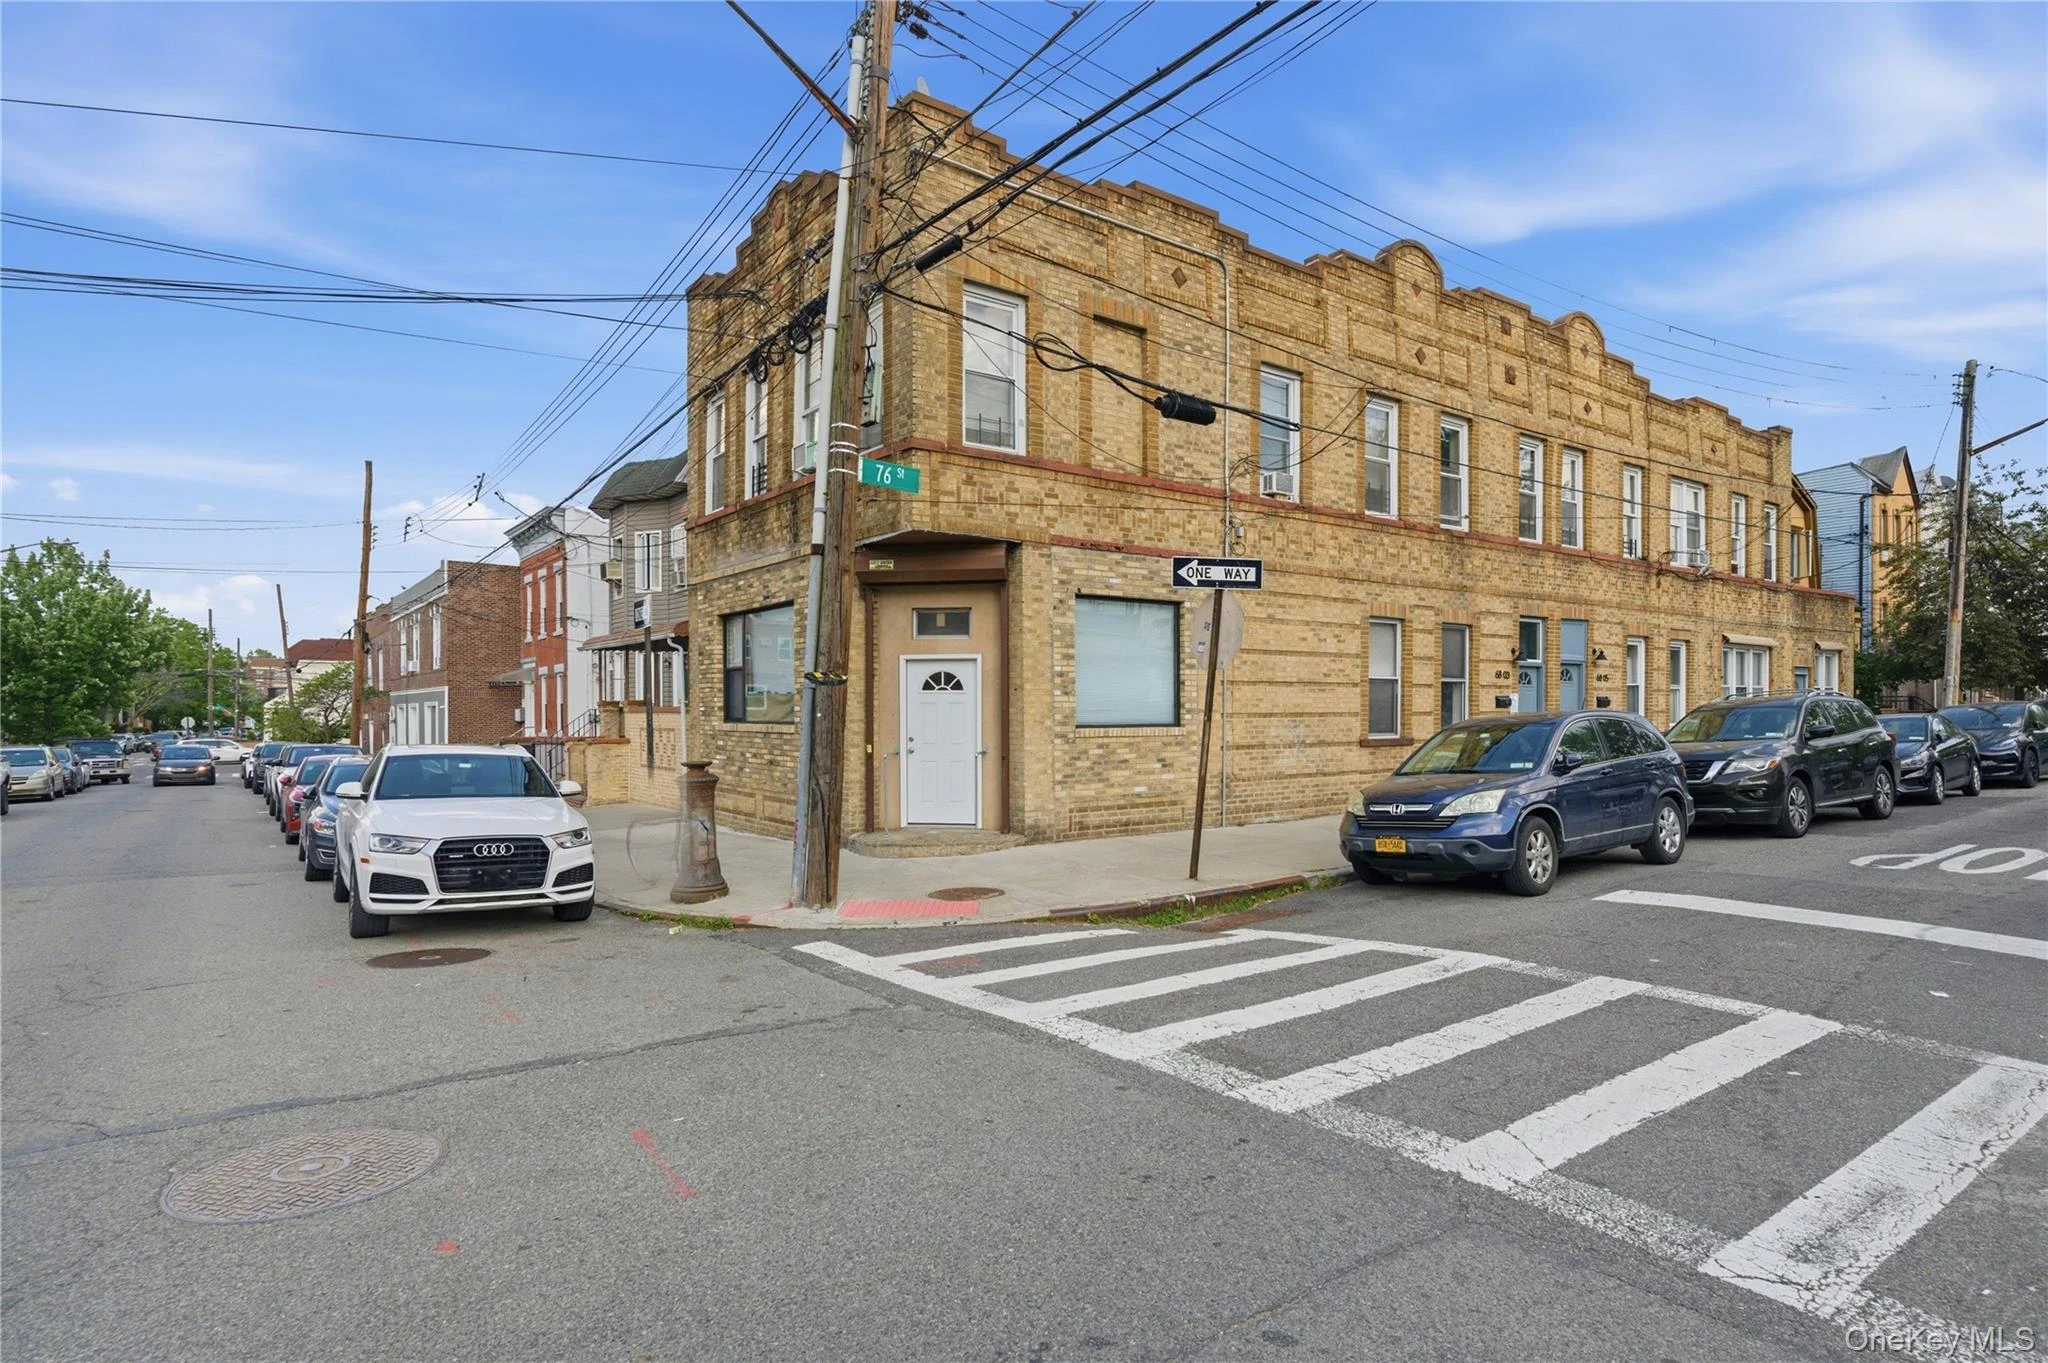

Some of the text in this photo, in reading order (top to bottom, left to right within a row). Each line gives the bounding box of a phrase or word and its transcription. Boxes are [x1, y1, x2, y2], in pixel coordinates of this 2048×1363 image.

[876, 464, 905, 484] 76 St
[1186, 567, 1251, 580] ONE WAY
